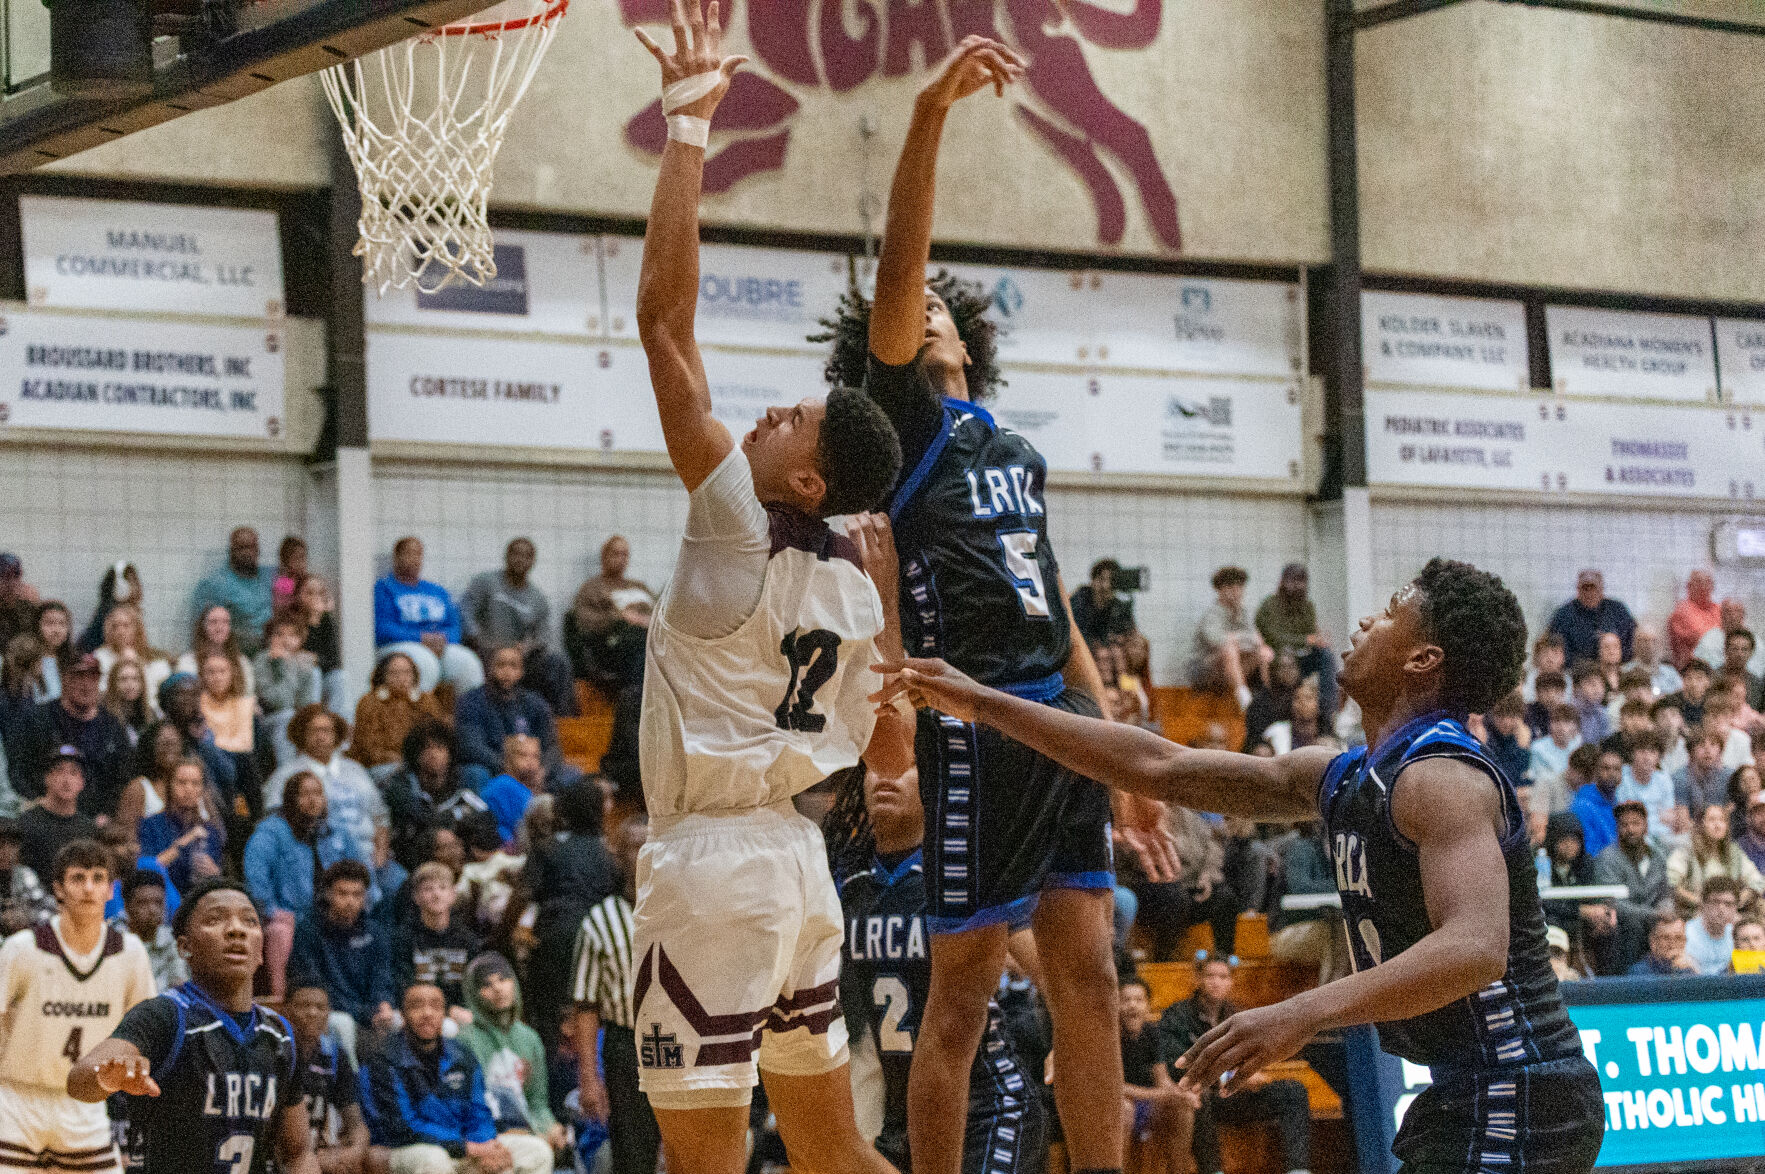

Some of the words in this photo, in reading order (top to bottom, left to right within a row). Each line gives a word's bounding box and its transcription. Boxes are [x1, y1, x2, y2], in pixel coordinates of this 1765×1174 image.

[107, 231, 201, 255] MANUEL
[217, 264, 254, 287] LLC
[26, 345, 128, 372] BROUSSARD
[20, 381, 99, 402] ACADIAN
[229, 391, 258, 413] INC
[409, 376, 487, 400] CORTESE
[493, 381, 561, 404] FAMILY
[1619, 466, 1696, 488] ASSOCIATES
[998, 531, 1050, 618] 5
[774, 628, 842, 733] 12
[849, 916, 926, 960] LRCA
[42, 1001, 111, 1019] COUGARS
[872, 976, 914, 1053] 2
[62, 1026, 84, 1064] 4
[204, 1072, 277, 1119] LRCA
[1604, 1084, 1728, 1132] THOLIC
